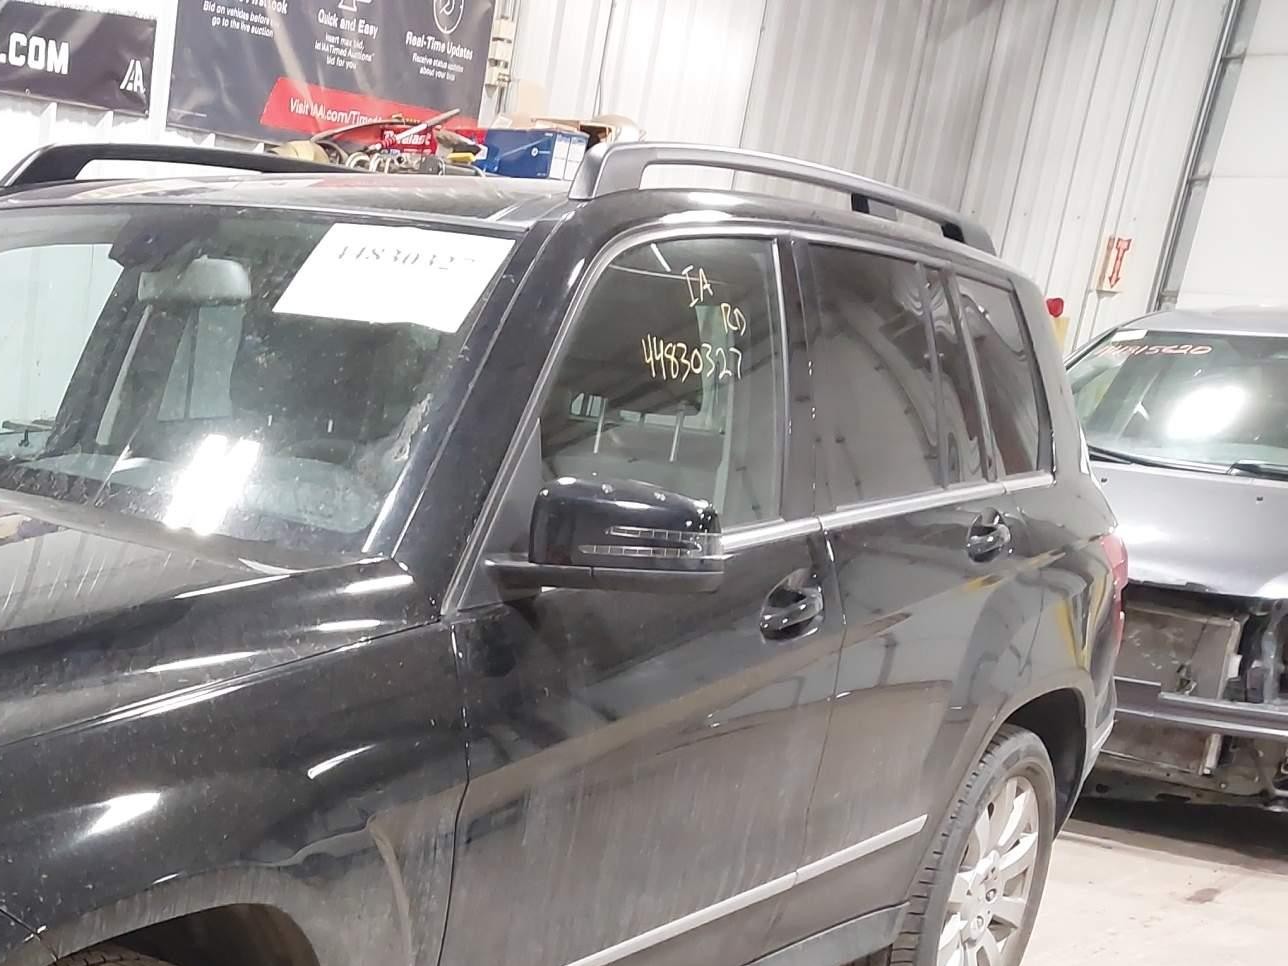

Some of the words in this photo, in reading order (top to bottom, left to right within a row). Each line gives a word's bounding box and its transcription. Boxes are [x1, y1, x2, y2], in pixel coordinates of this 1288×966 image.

[203, 0, 216, 12] Bid
[216, 5, 226, 14] on
[226, 7, 250, 21] vehicles
[250, 11, 270, 25] before
[211, 16, 221, 26] go
[222, 17, 229, 26] to
[230, 18, 240, 29] the
[240, 21, 250, 32] live
[250, 25, 274, 38] auction
[318, 8, 339, 28] Quick
[339, 18, 357, 32] and
[358, 19, 379, 39] Easy
[405, 31, 446, 53] Real-Time
[446, 41, 473, 60] Updates
[336, 56, 345, 67] for
[345, 60, 357, 70] you
[289, 97, 309, 116] Visit
[309, 102, 383, 126] IAAI.com/Timed
[642, 334, 743, 383] 44830327
